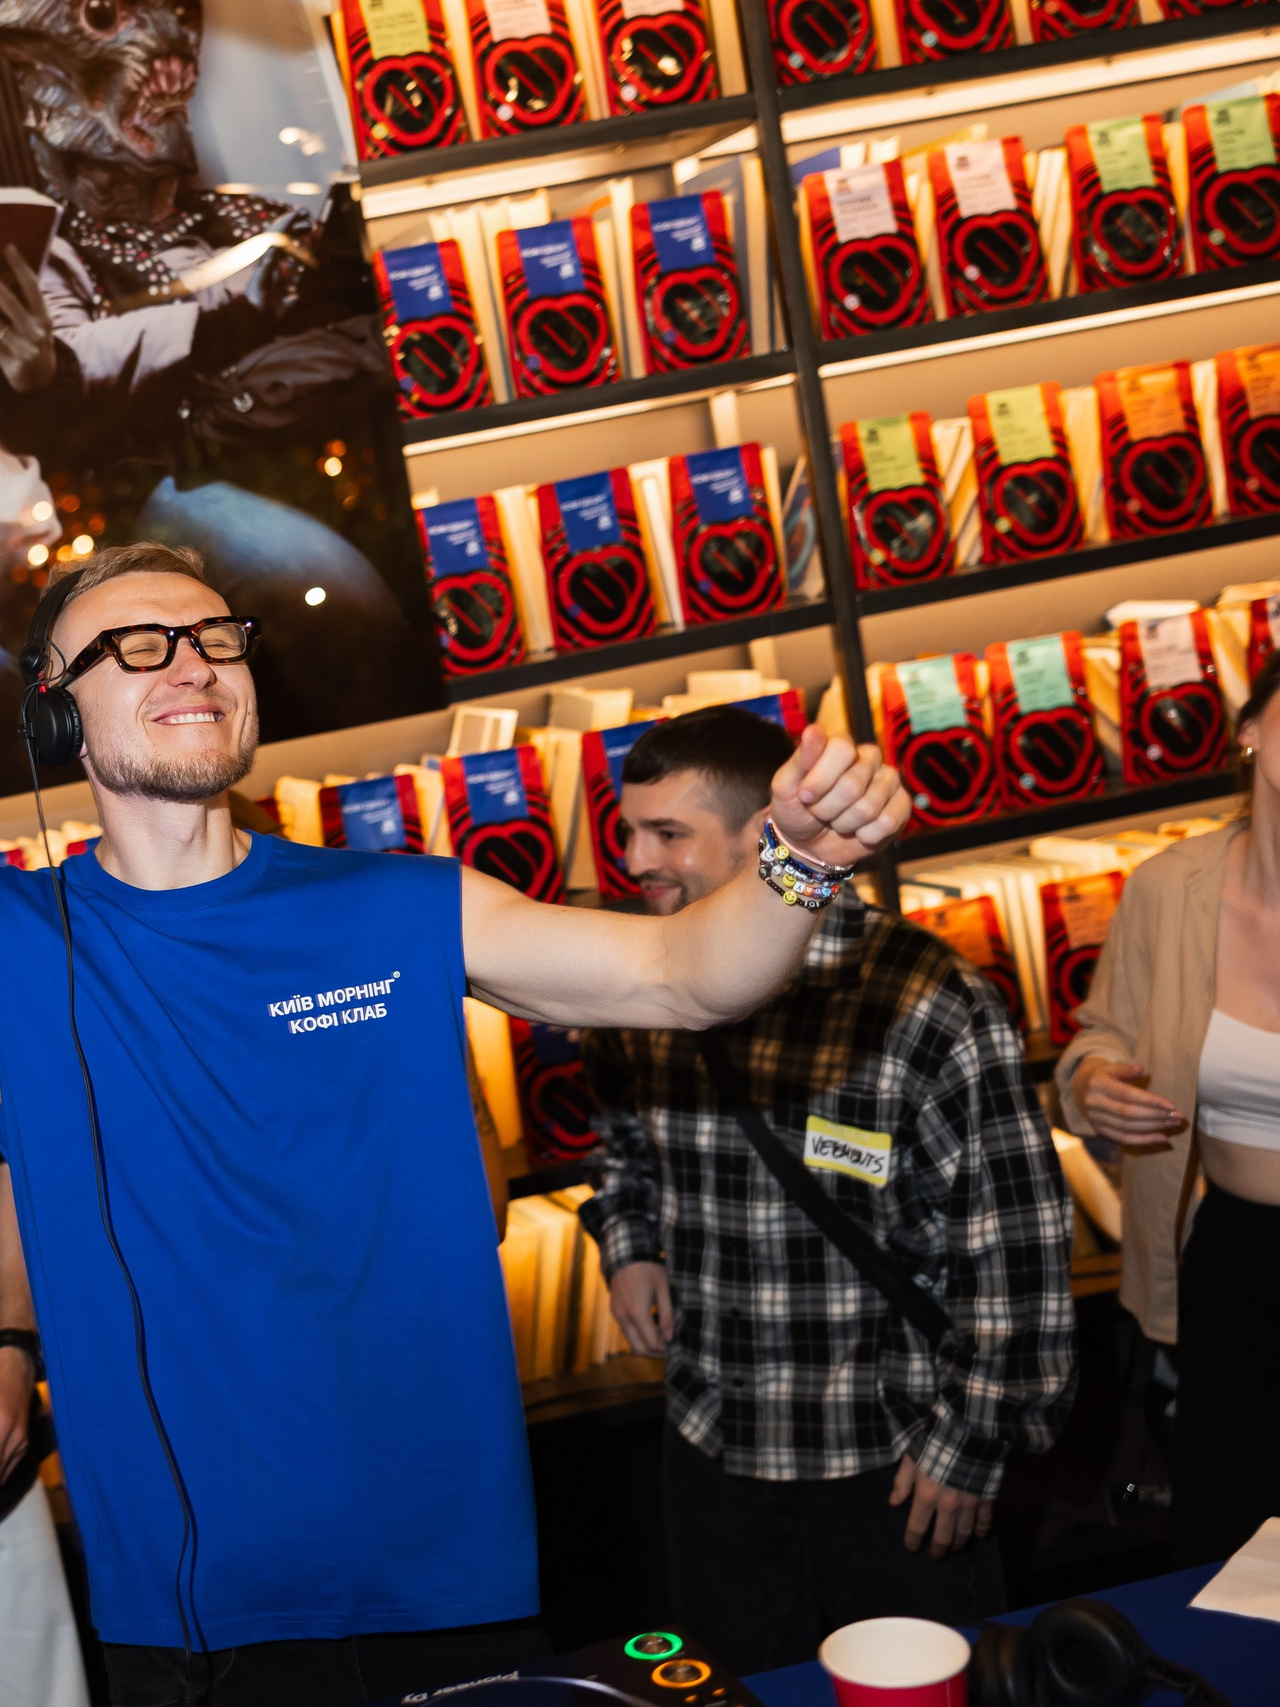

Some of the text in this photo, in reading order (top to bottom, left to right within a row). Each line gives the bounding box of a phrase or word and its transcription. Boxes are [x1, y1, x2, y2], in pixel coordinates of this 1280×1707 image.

[268, 995, 315, 1018] КИЇВ
[289, 1002, 388, 1035] КОФІ КЛАБ
[431, 1670, 519, 1698] Pioneer
